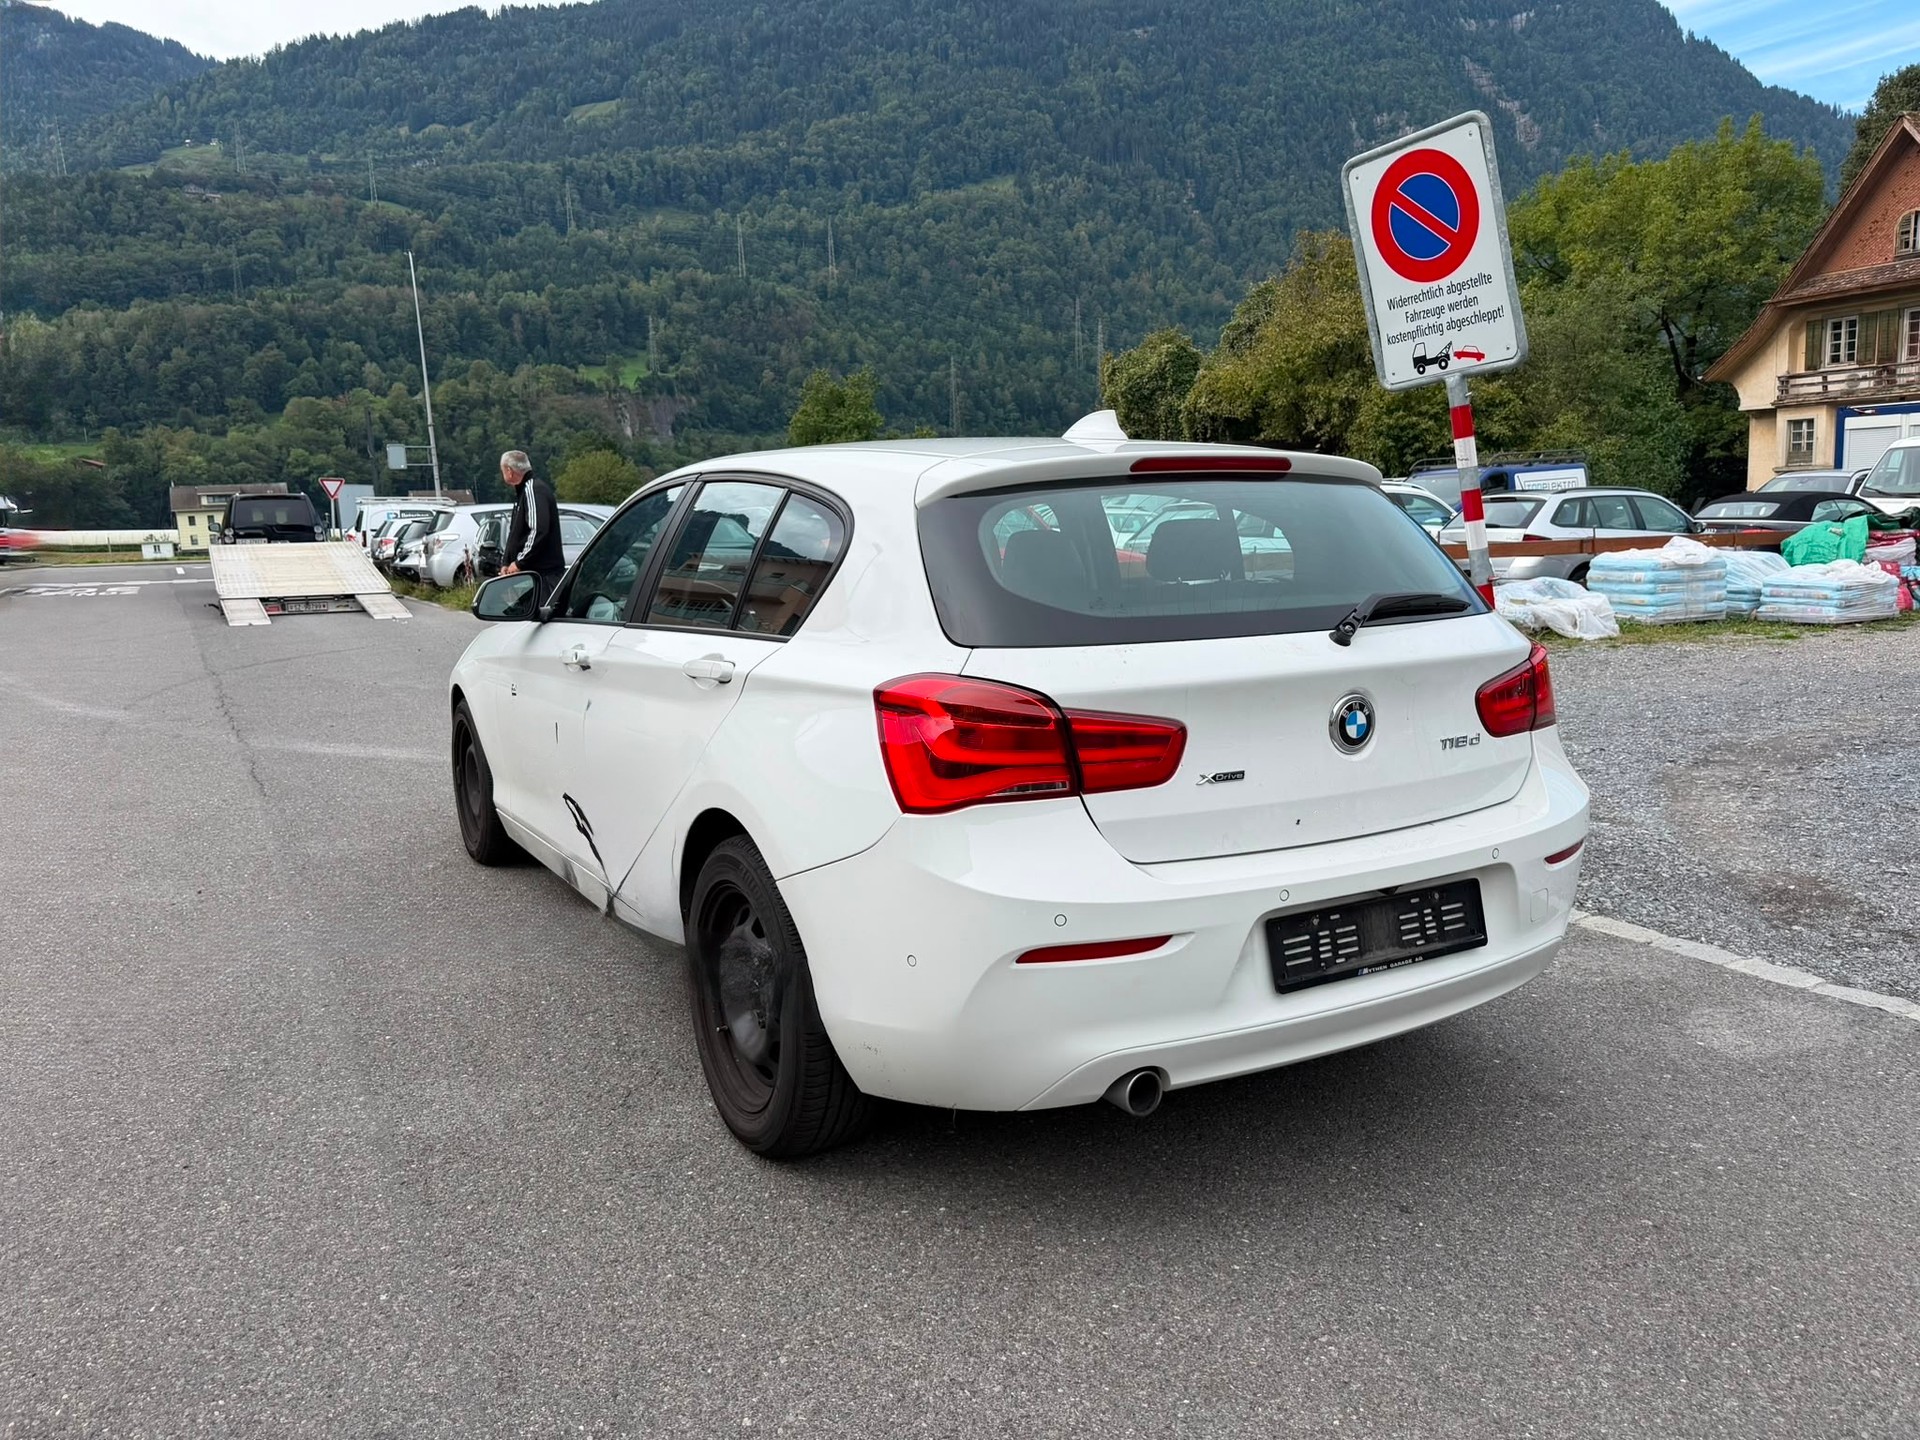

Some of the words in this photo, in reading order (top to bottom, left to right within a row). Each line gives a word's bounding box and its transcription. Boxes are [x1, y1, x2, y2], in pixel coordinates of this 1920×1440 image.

[1387, 285, 1444, 311] Widerrechtlich
[1446, 272, 1493, 295] abgestellte
[1405, 306, 1446, 323] Fahrzeuge
[1447, 295, 1479, 313] werden
[1386, 321, 1444, 346] kostenpflichtig
[1446, 305, 1505, 331] abgeschleppt!
[1340, 702, 1370, 718] BMW
[1440, 732, 1480, 750] 118d
[1390, 959, 1412, 968] GARAGE
